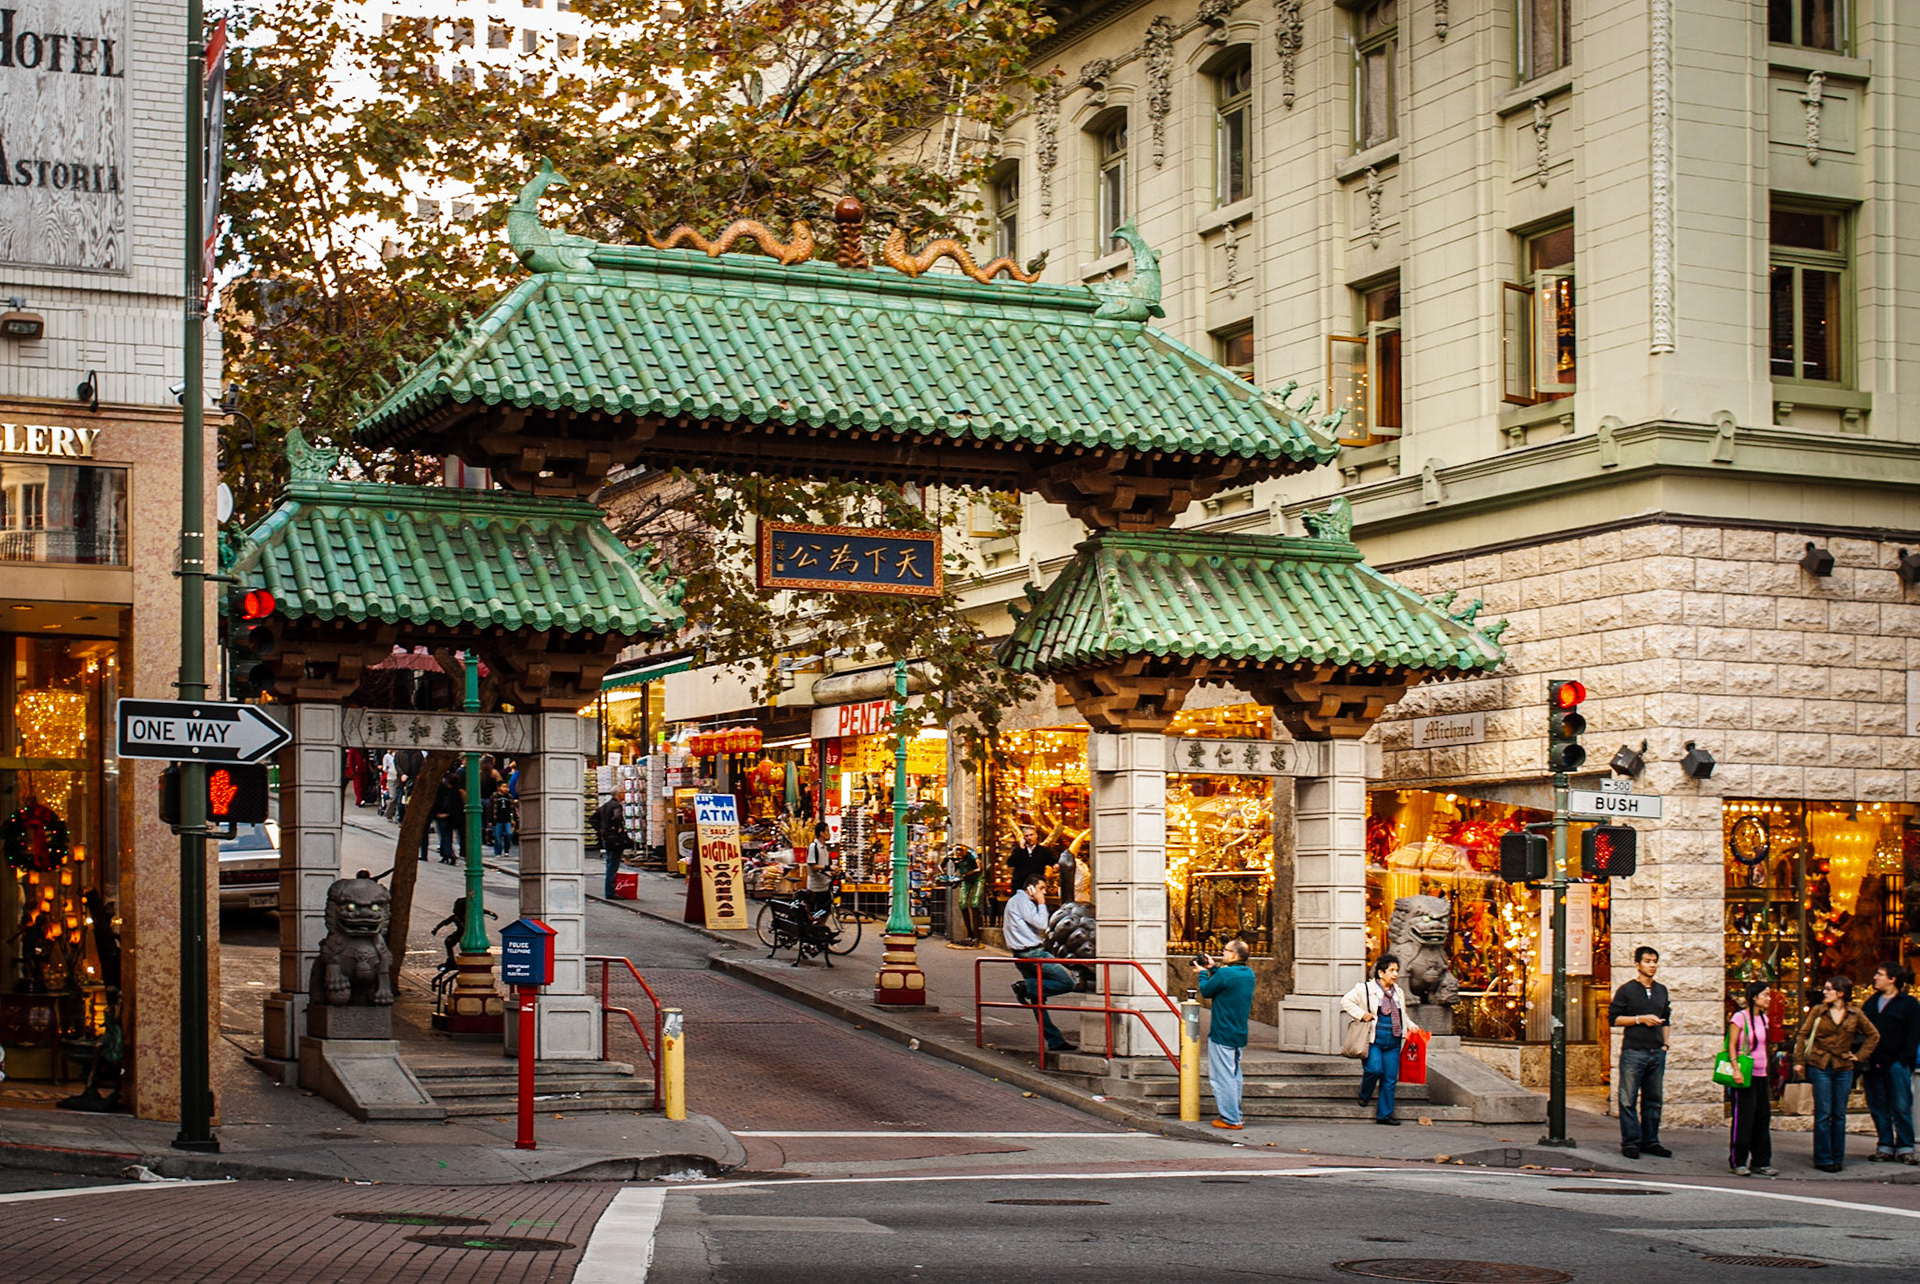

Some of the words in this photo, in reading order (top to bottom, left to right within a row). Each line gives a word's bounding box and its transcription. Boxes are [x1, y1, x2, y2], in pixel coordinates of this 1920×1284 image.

[0, 423, 100, 457] LERY
[132, 719, 176, 741] ONE
[186, 722, 231, 744] WAY
[1422, 718, 1474, 744] Michael
[1613, 781, 1631, 791] 500
[700, 809, 735, 822] ATM
[1595, 796, 1638, 812] BUSH
[702, 840, 739, 863] DIGITAL
[713, 863, 735, 918] CAMERAS
